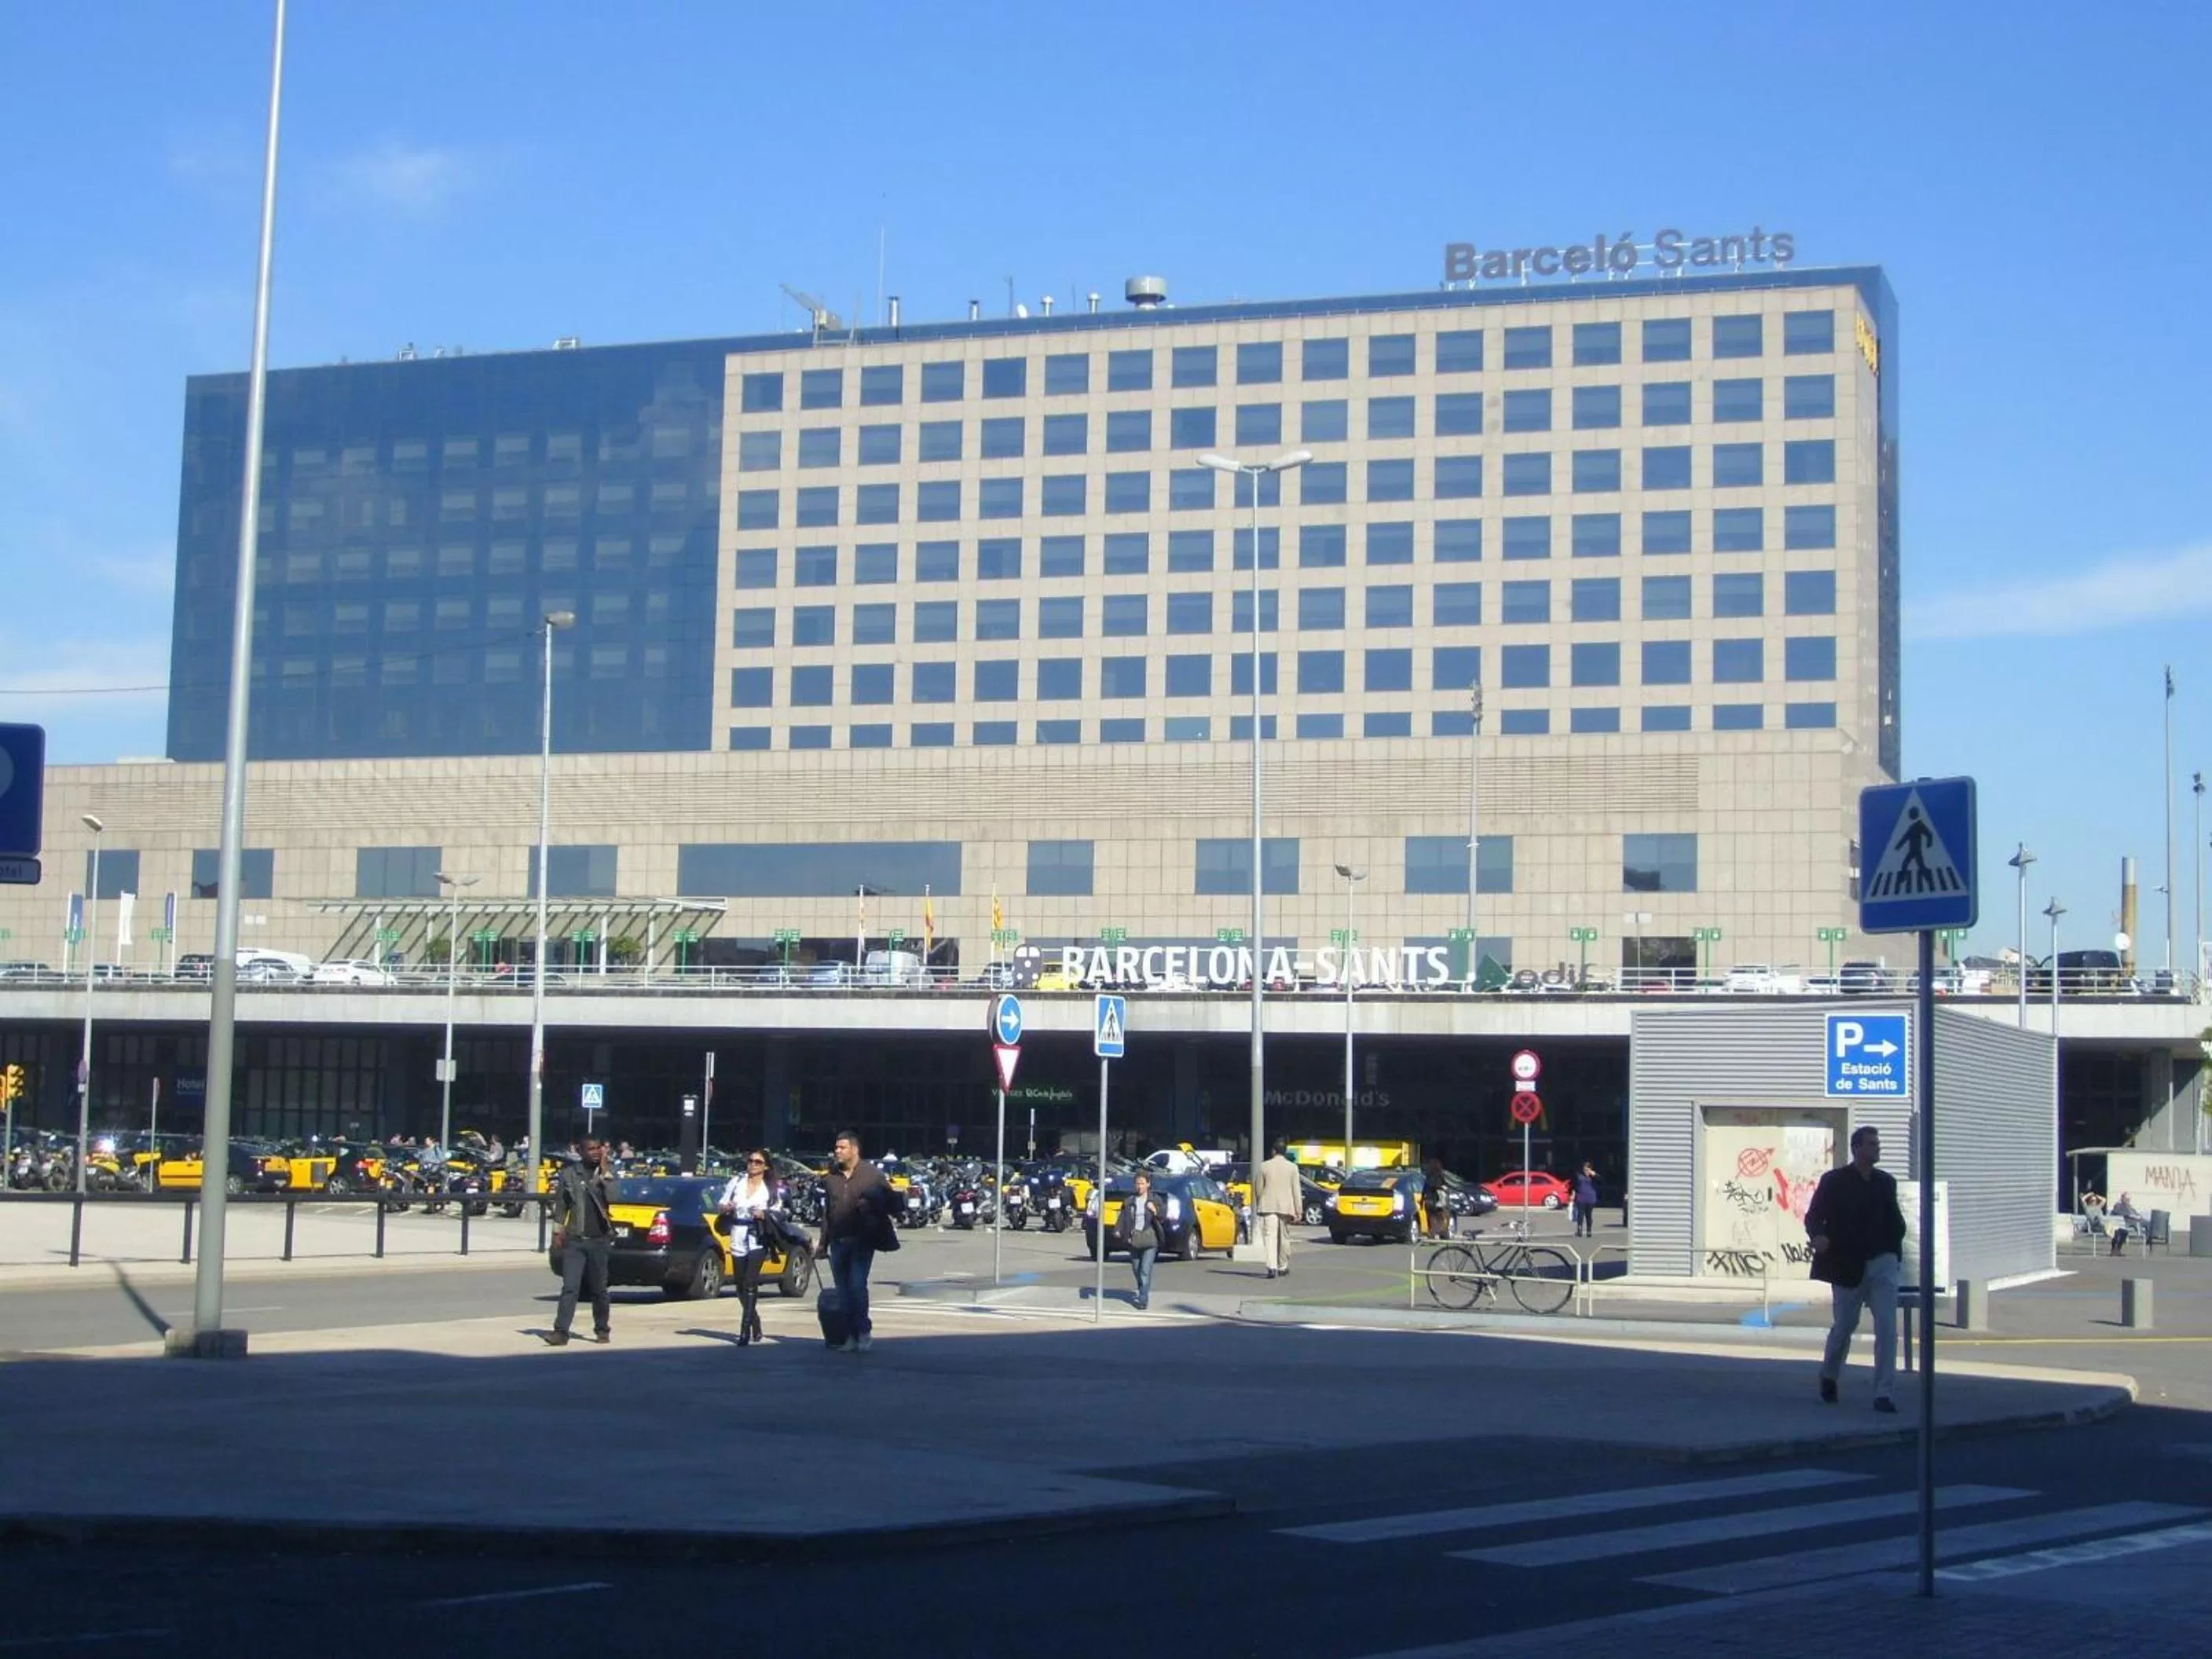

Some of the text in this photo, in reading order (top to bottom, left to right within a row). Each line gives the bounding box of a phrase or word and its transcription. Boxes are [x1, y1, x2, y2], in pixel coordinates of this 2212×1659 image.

[1445, 225, 1796, 281] Barceló Sants
[1837, 1022, 1863, 1057] P
[1841, 1062, 1892, 1075] Estació
[1835, 1077, 1899, 1090] de Sants
